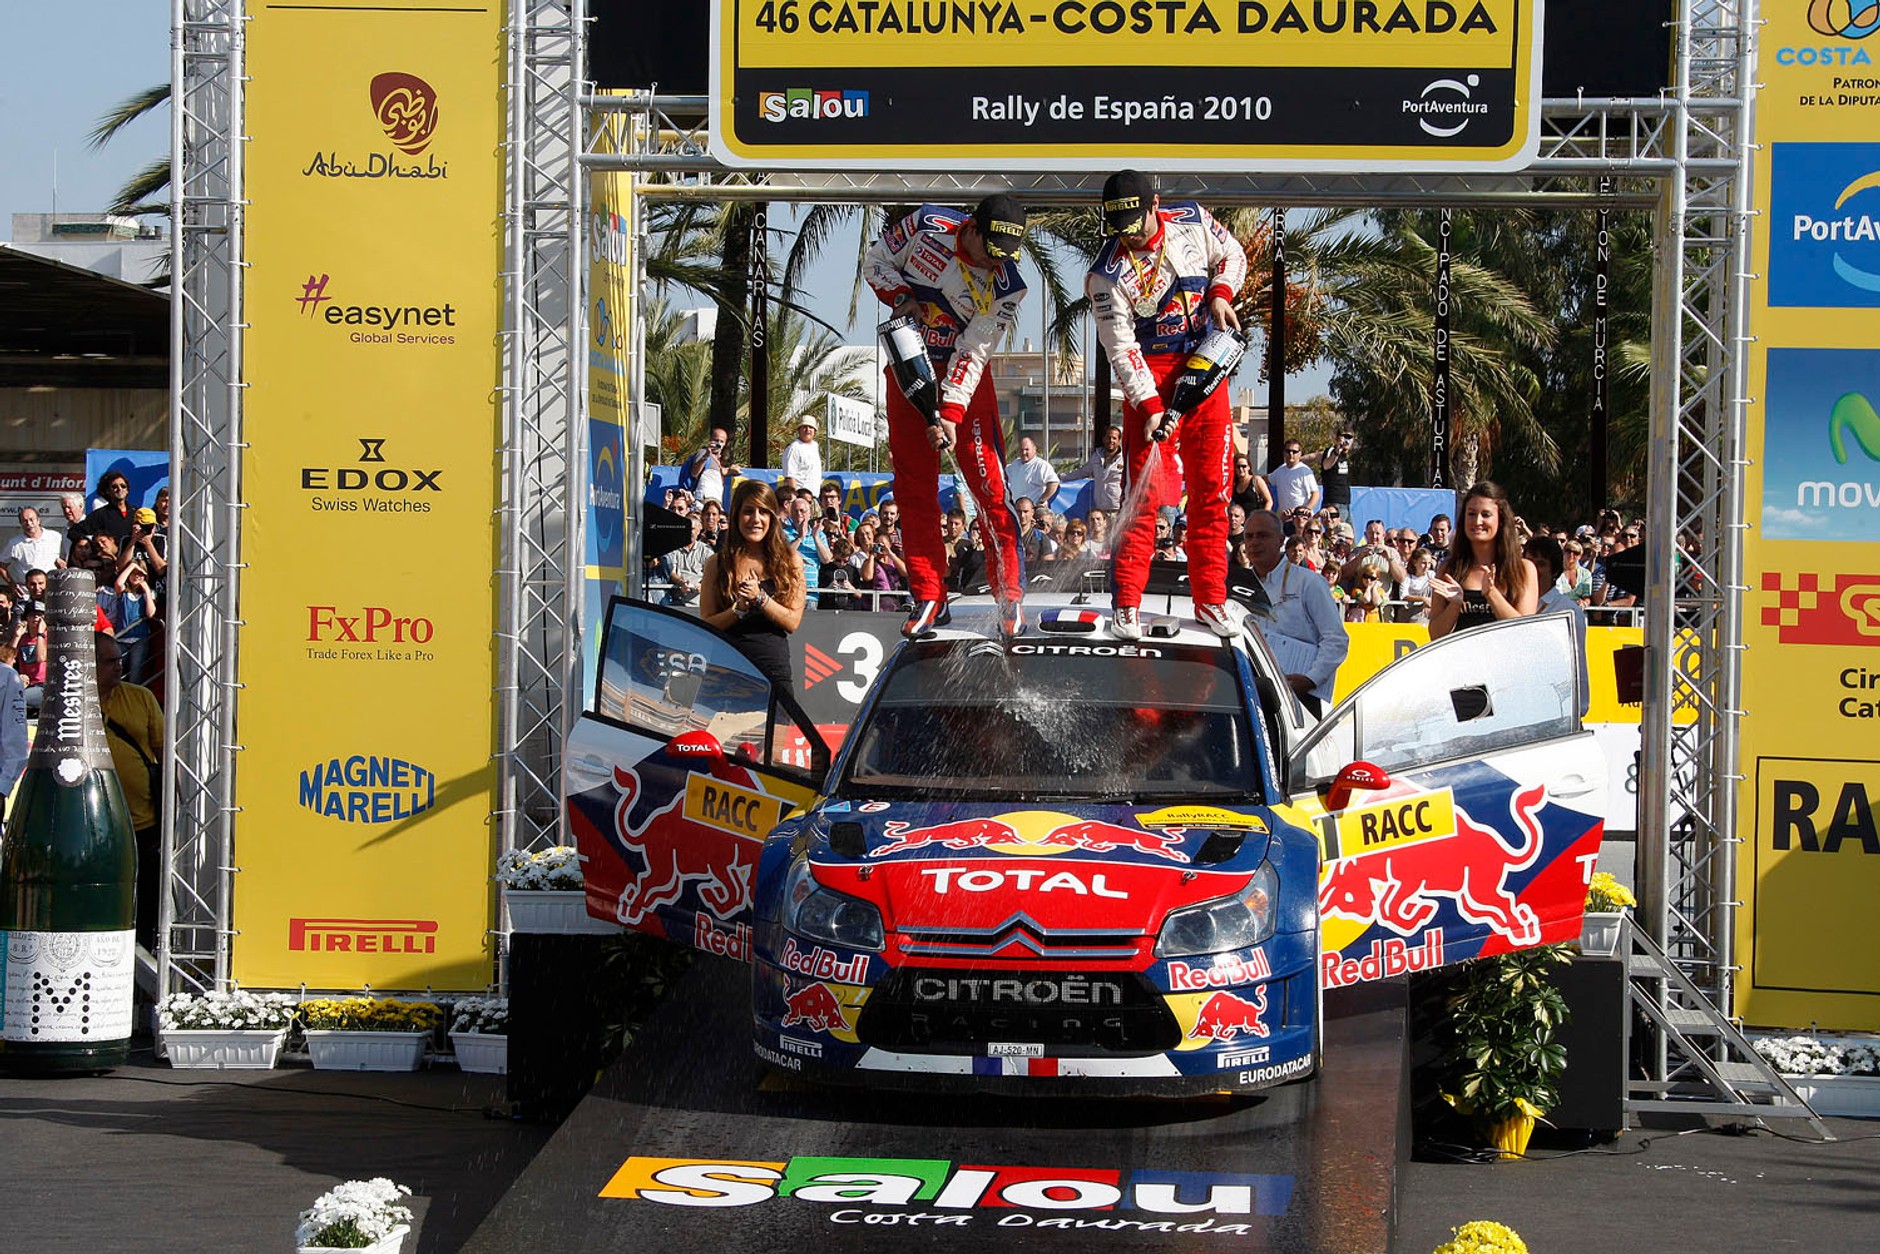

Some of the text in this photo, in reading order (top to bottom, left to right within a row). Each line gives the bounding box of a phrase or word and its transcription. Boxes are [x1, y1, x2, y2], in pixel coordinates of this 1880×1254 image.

[756, 1, 799, 34] 46
[1237, 1, 1498, 35] DAURADA
[1776, 47, 1872, 66] COSTA
[764, 93, 865, 123] Salou
[972, 94, 1272, 126] Rally de España 2010
[1402, 99, 1488, 114] PortAventura
[753, 212, 767, 349] CANARIAS
[1596, 273, 1607, 306] DE
[324, 301, 456, 330] easynet
[1156, 316, 1188, 337] Red
[350, 331, 456, 346] Global Services
[926, 329, 957, 348] Bull
[1436, 328, 1448, 361] DE
[1594, 316, 1606, 411] MURCIA
[301, 468, 443, 492] EDOX
[311, 496, 431, 513] Swiss Watches
[305, 605, 434, 644] FxPro
[306, 648, 434, 662] Trade Forex Like a Pro
[676, 743, 712, 752] TOTAL
[701, 785, 761, 832] RACC
[1360, 800, 1433, 846] RACC
[1772, 779, 1880, 855] RA
[920, 866, 1130, 900] TOTAL
[288, 917, 439, 954] PIRELLI
[694, 911, 744, 958] Red
[779, 937, 822, 974] Red
[815, 949, 871, 986] Bull
[1321, 927, 1444, 990] Red Bull
[779, 1034, 823, 1059] PIRELLI
[991, 1044, 1041, 1056] AJ-520-MN
[1216, 1046, 1270, 1069] PIRELLI
[1239, 1053, 1312, 1085] EURODATACAR
[635, 1163, 1252, 1214] Salou
[829, 1209, 1253, 1237] Costa Daurada
